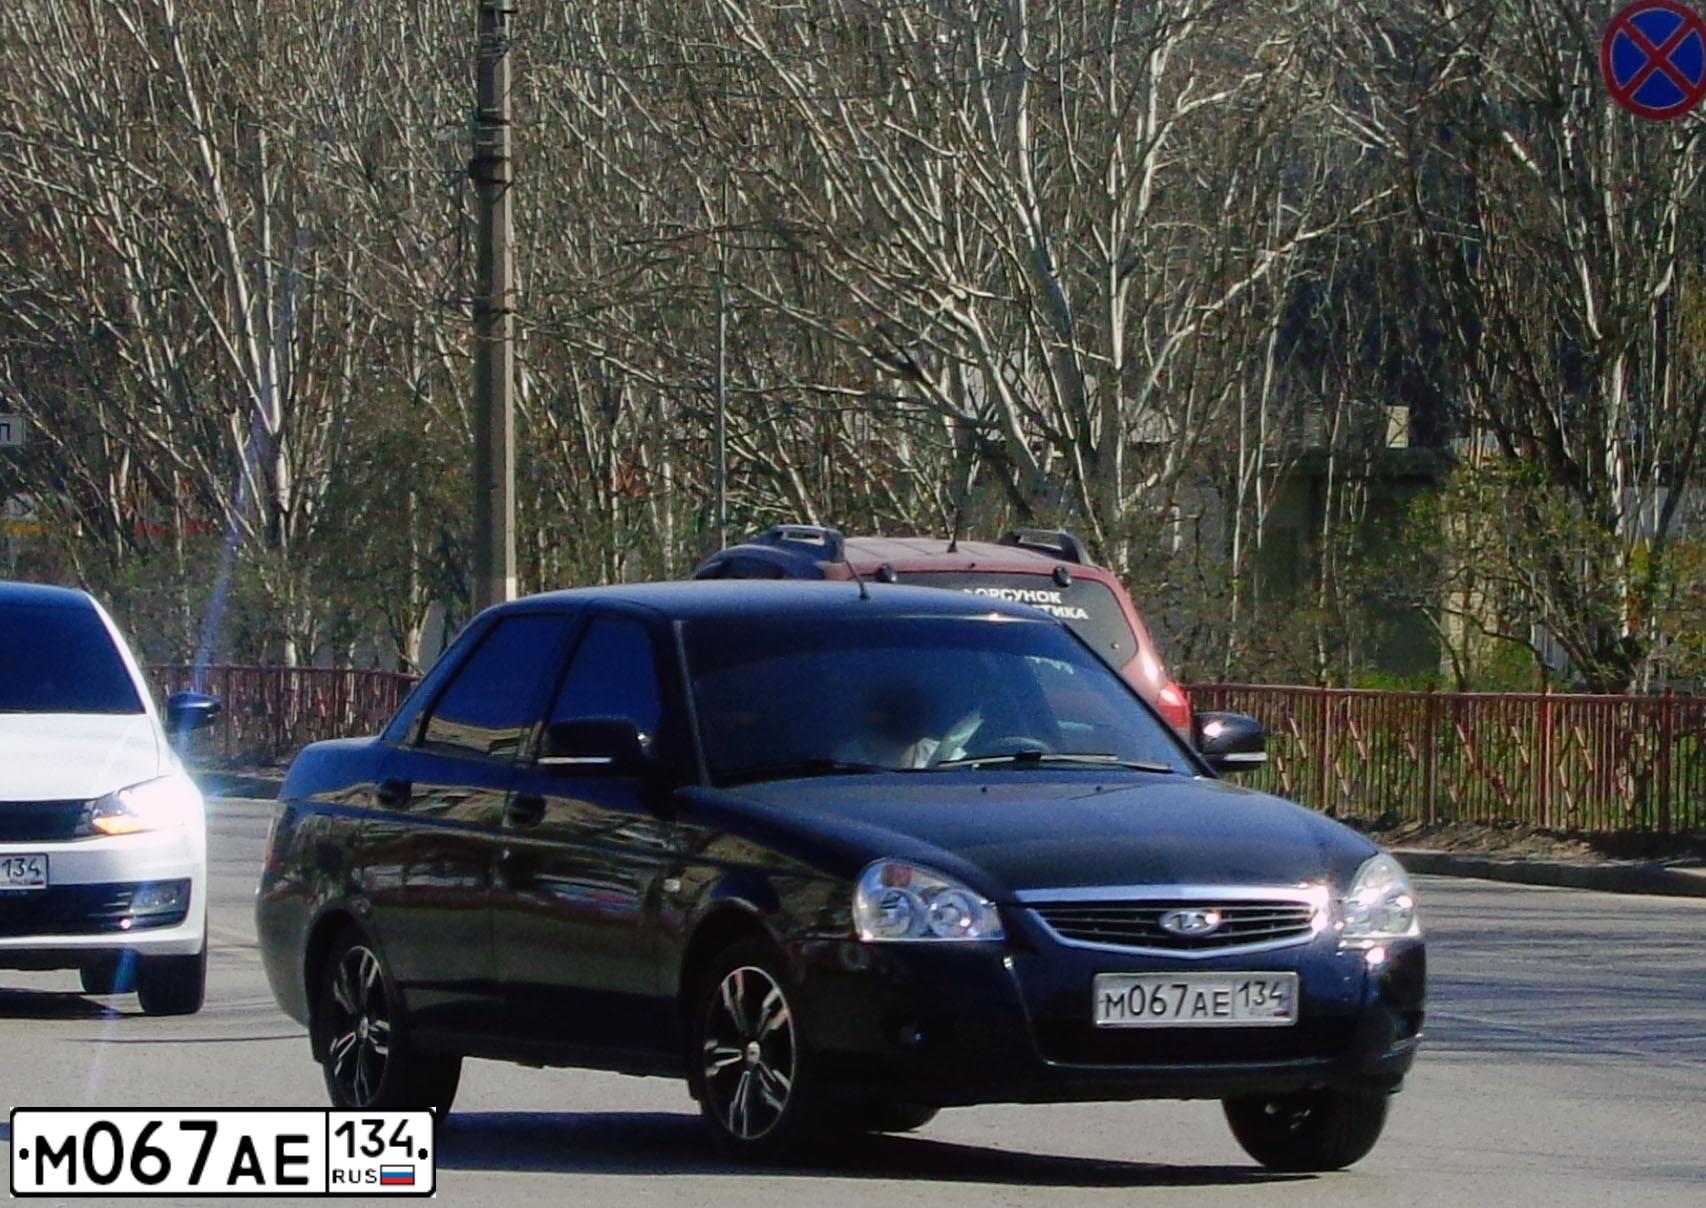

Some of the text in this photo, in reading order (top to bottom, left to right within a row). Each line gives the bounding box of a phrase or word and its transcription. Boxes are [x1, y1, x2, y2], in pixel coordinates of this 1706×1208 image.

[963, 588, 1062, 604] ОРСУНОК
[1032, 604, 1089, 620] ТИКА
[1, 857, 41, 878] 134
[1104, 981, 1283, 1018] М067АЕ 134
